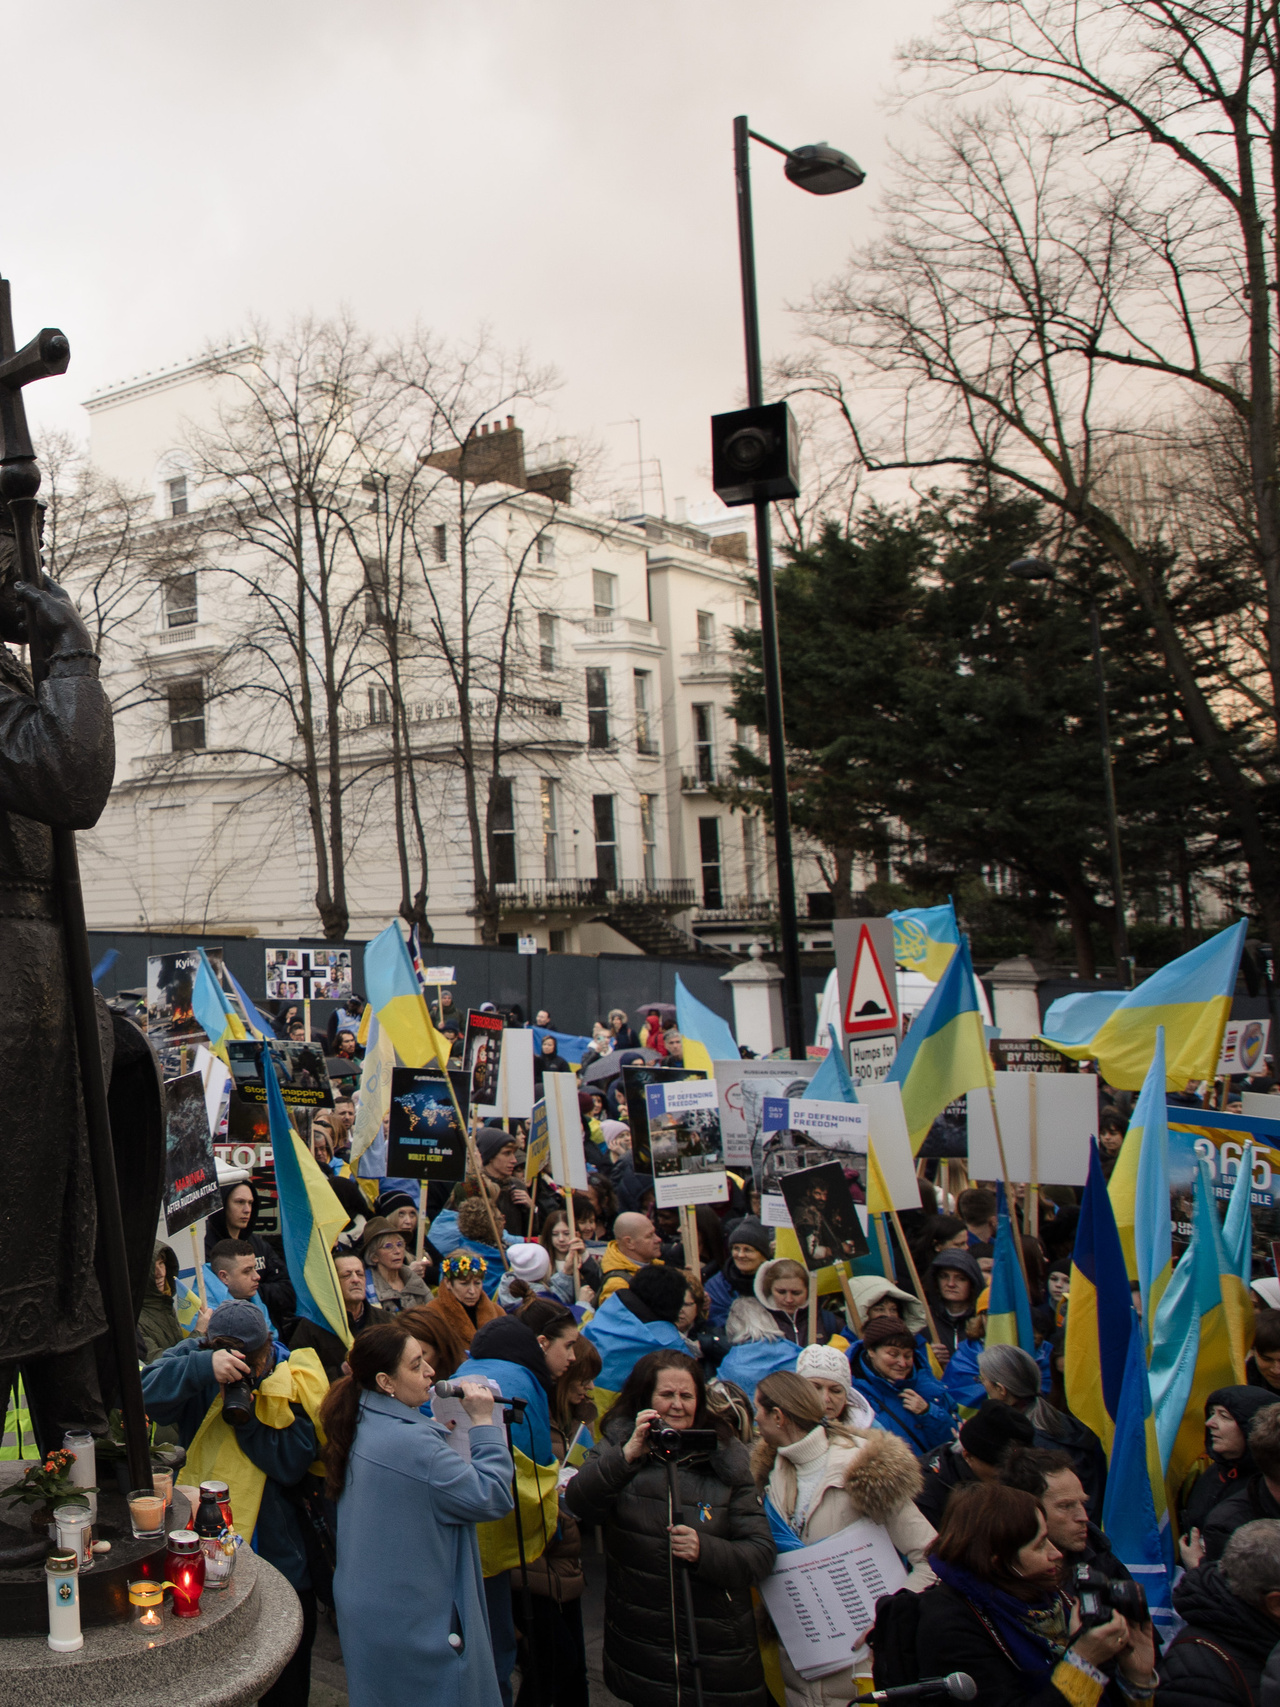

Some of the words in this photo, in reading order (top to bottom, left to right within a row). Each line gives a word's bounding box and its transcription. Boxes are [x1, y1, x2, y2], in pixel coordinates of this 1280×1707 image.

[175, 958, 195, 969] Kyiv
[853, 1048, 880, 1062] Humps
[882, 1044, 894, 1057] for
[999, 1043, 1030, 1051] UKRAINE
[1007, 1052, 1022, 1061] BY
[1023, 1052, 1062, 1062] RUSSIA
[855, 1066, 871, 1079] 500
[874, 1062, 891, 1079] yard
[1006, 1064, 1039, 1072] EVERY
[794, 1119, 838, 1128] FREEDOM
[808, 1113, 861, 1123] DEFENDING
[214, 1146, 274, 1169] TOP
[1194, 1138, 1272, 1190] 365
[175, 1168, 206, 1192] MARINKA
[167, 1202, 180, 1215] AFTER
[199, 1182, 218, 1199] ATTACK
